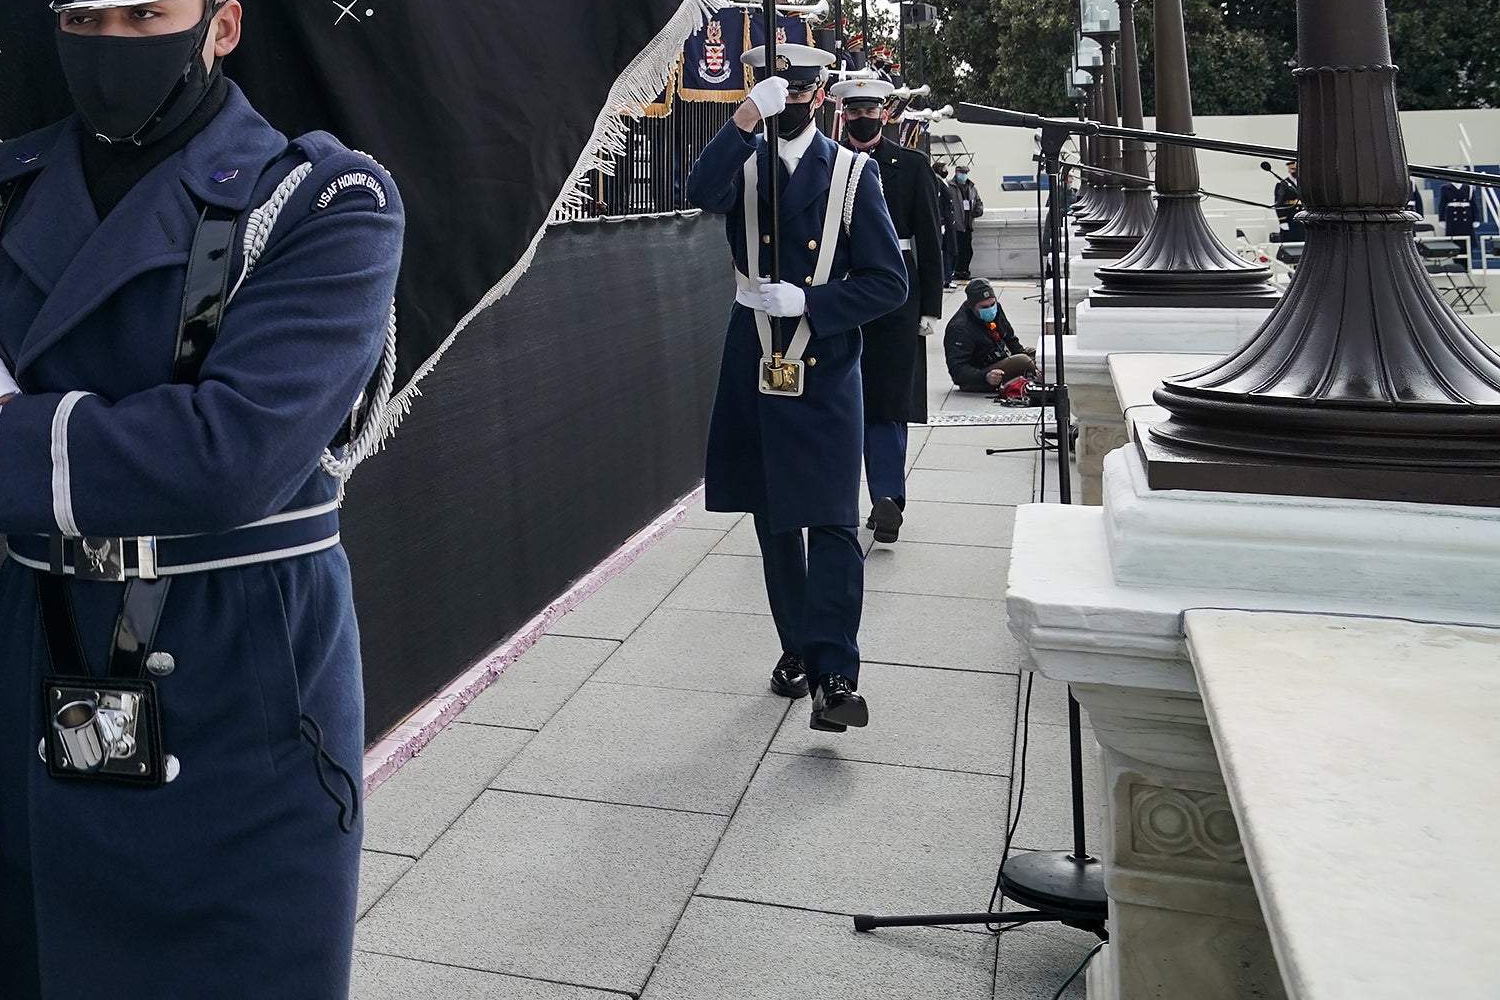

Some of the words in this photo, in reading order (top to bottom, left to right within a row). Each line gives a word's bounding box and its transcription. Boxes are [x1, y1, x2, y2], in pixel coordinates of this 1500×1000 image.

[317, 182, 339, 209] USAF
[337, 172, 368, 191] HONOR
[366, 175, 386, 208] GUARD
